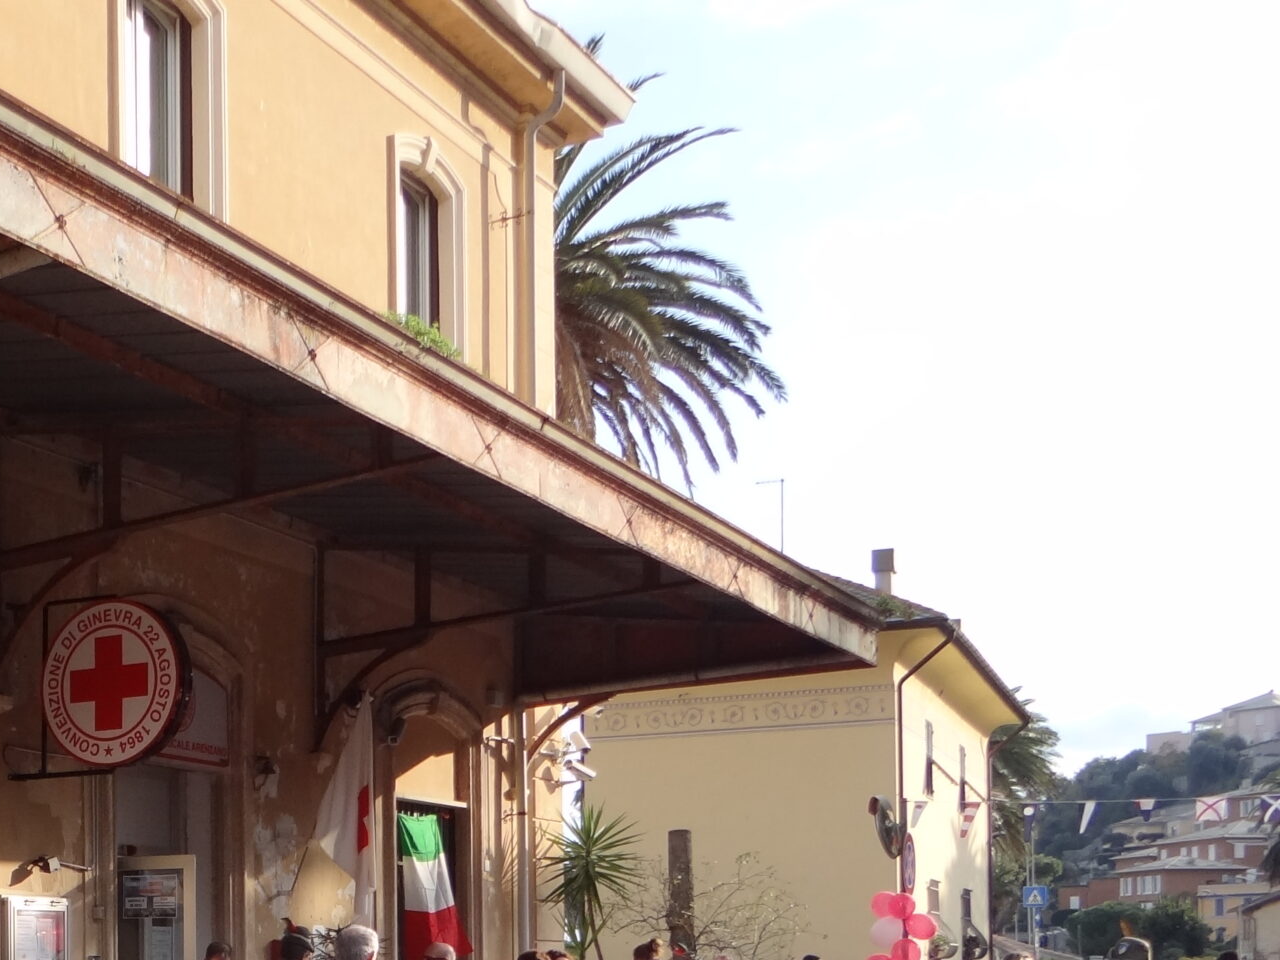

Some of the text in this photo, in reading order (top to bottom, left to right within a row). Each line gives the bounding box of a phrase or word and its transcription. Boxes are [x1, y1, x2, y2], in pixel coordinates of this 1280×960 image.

[47, 608, 172, 757] CONVENZIONE DI GINEVRA 22 AGOSTO 1864
